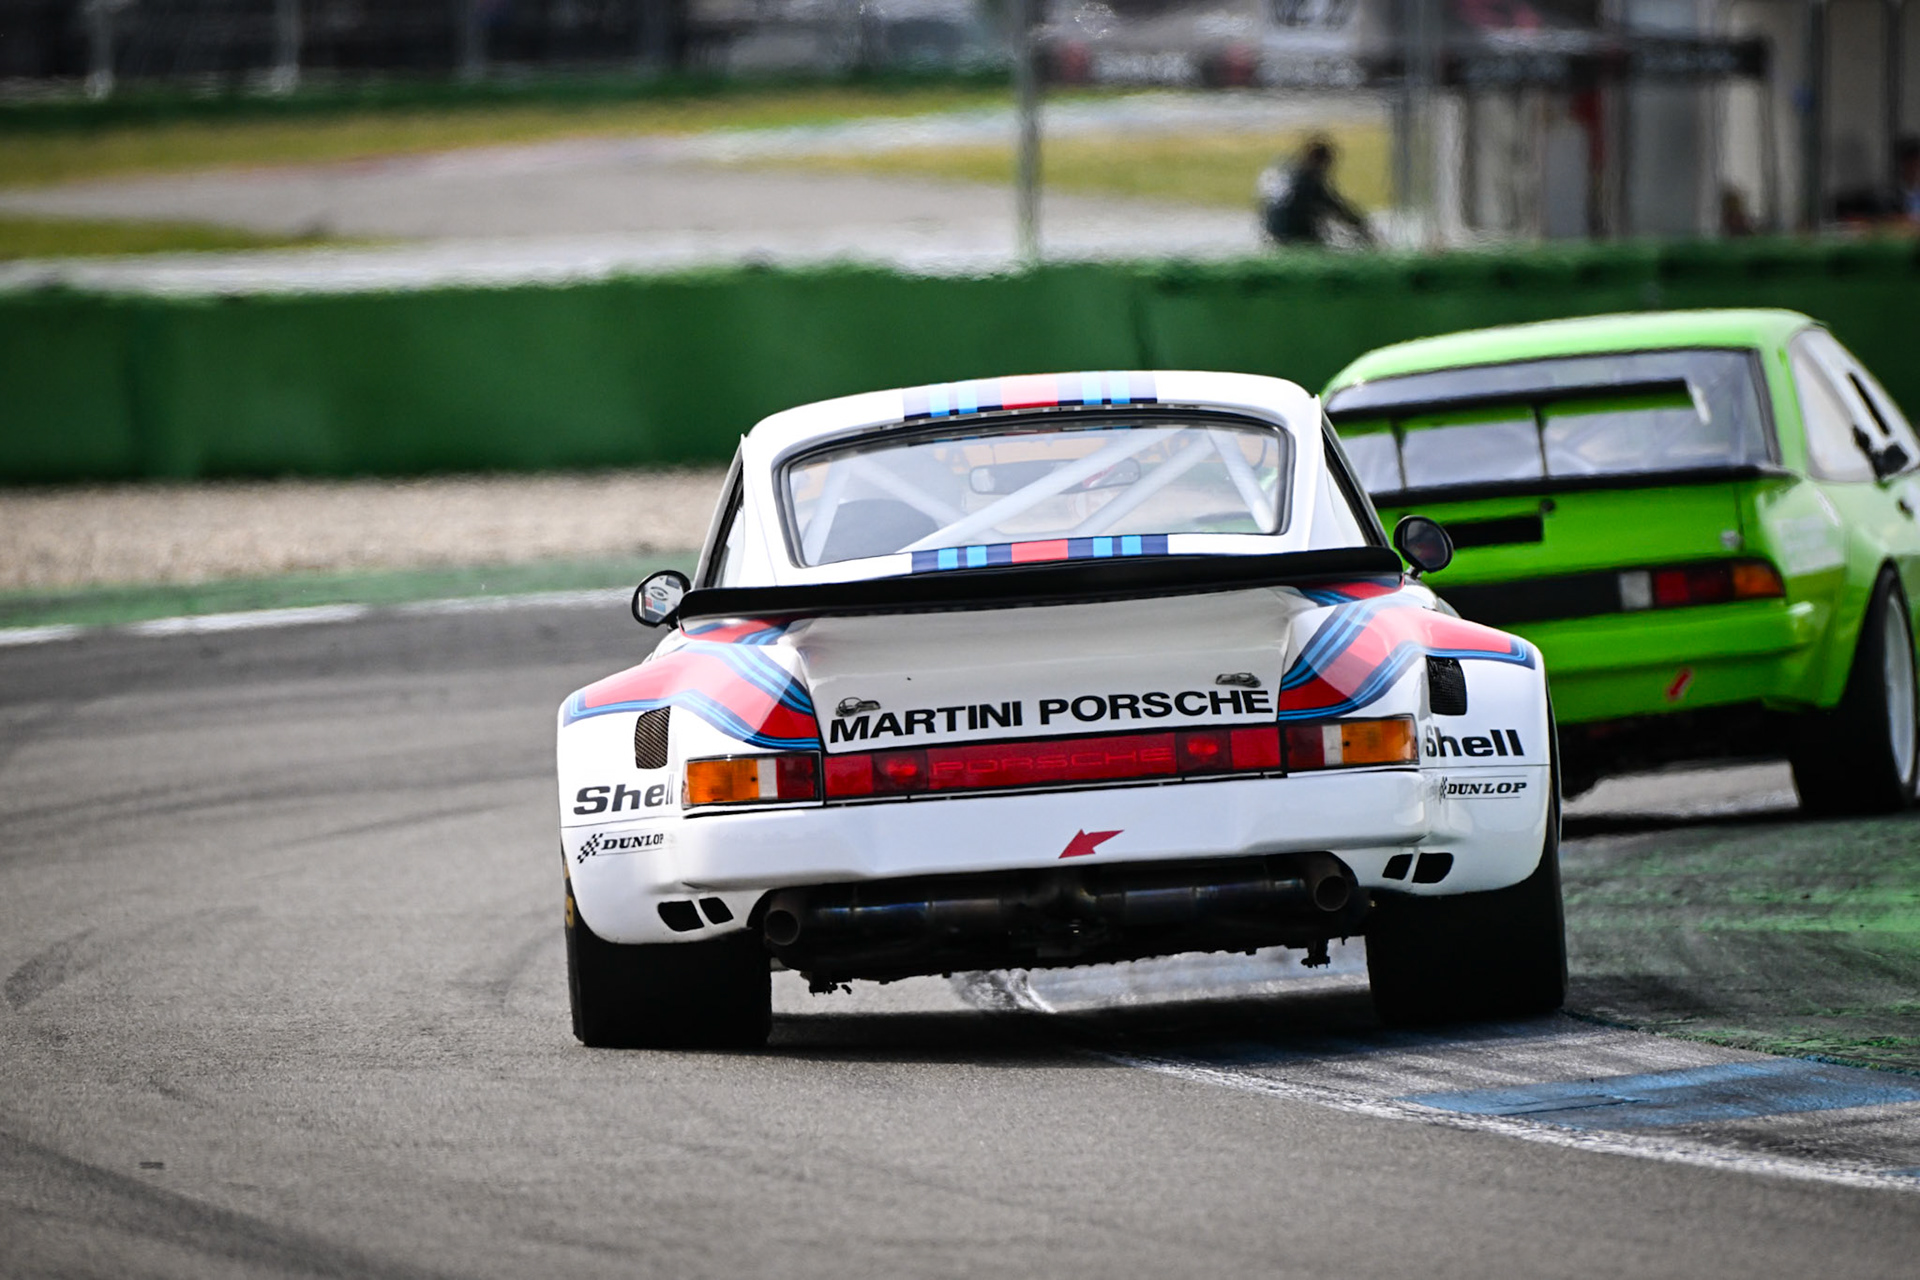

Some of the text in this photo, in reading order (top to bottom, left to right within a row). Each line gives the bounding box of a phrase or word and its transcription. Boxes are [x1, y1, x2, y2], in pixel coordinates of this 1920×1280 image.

[830, 690, 1273, 743] MARTINI PORSCHE
[1426, 725, 1524, 757] Shell
[933, 747, 1173, 776] PORSCHE
[1447, 782, 1527, 795] DUNLOP
[601, 833, 664, 850] DUNLOP
